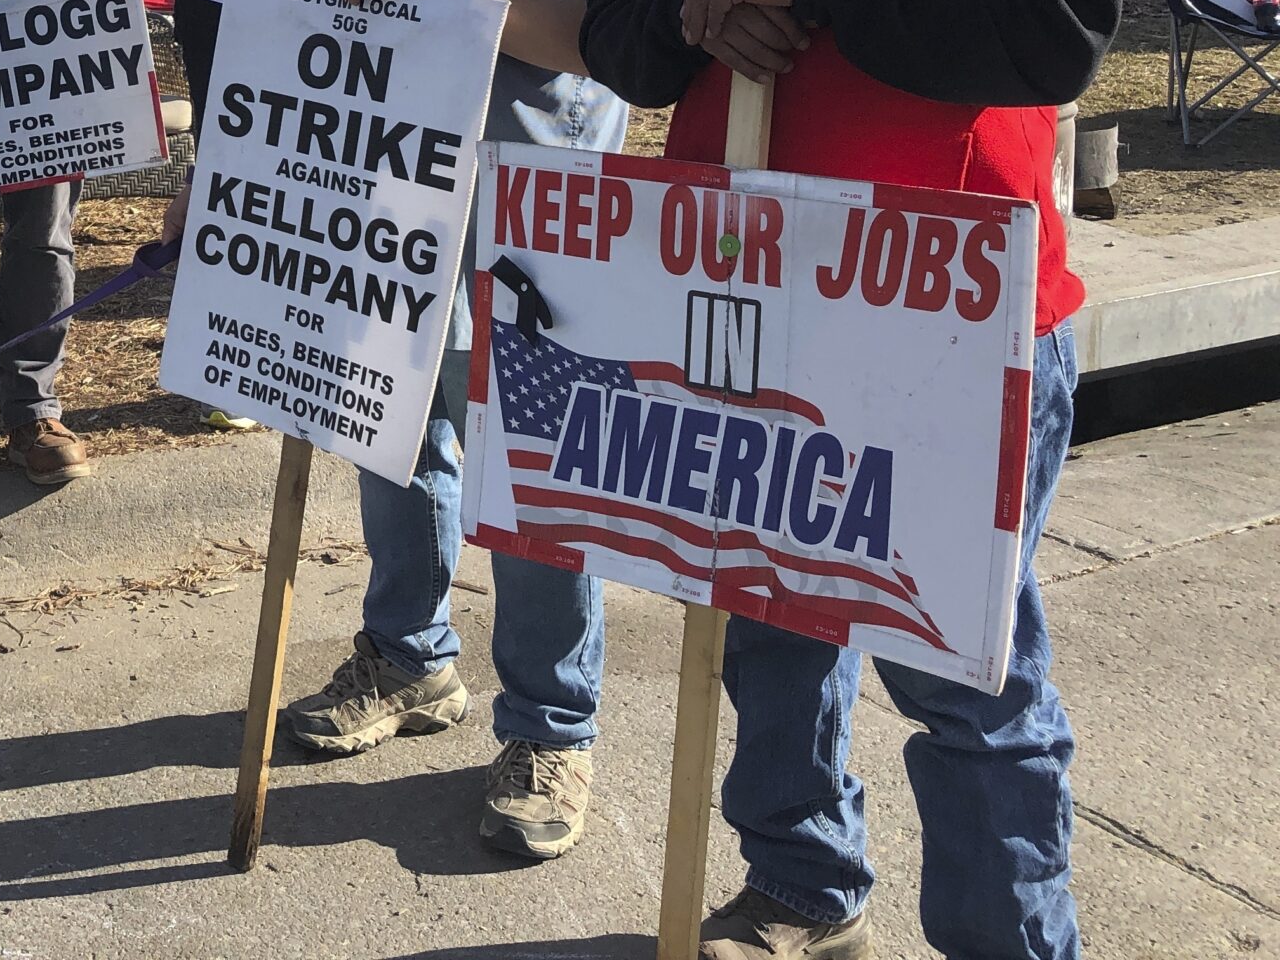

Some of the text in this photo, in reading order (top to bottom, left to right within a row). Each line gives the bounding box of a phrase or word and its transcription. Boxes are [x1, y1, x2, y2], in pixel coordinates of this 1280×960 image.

[332, 13, 368, 35] 50G
[297, 33, 394, 103] ON
[0, 137, 125, 169] CONDITIONS
[9, 113, 55, 134] FOR
[29, 121, 125, 150] BENEFITS
[218, 82, 462, 193] STRIKE
[276, 157, 377, 200] AGAINST
[207, 172, 438, 275] KELLOGG
[494, 164, 1006, 323] KEEP OUR JOBS
[195, 223, 437, 333] COMPANY
[284, 304, 325, 334] FOR
[206, 339, 385, 422] AND CONDITIONS
[207, 311, 394, 395] WAGES, BENEFITS
[684, 290, 761, 399] IN
[204, 366, 378, 447] OF EMPLOYMENT
[554, 387, 894, 562] AMERICA
